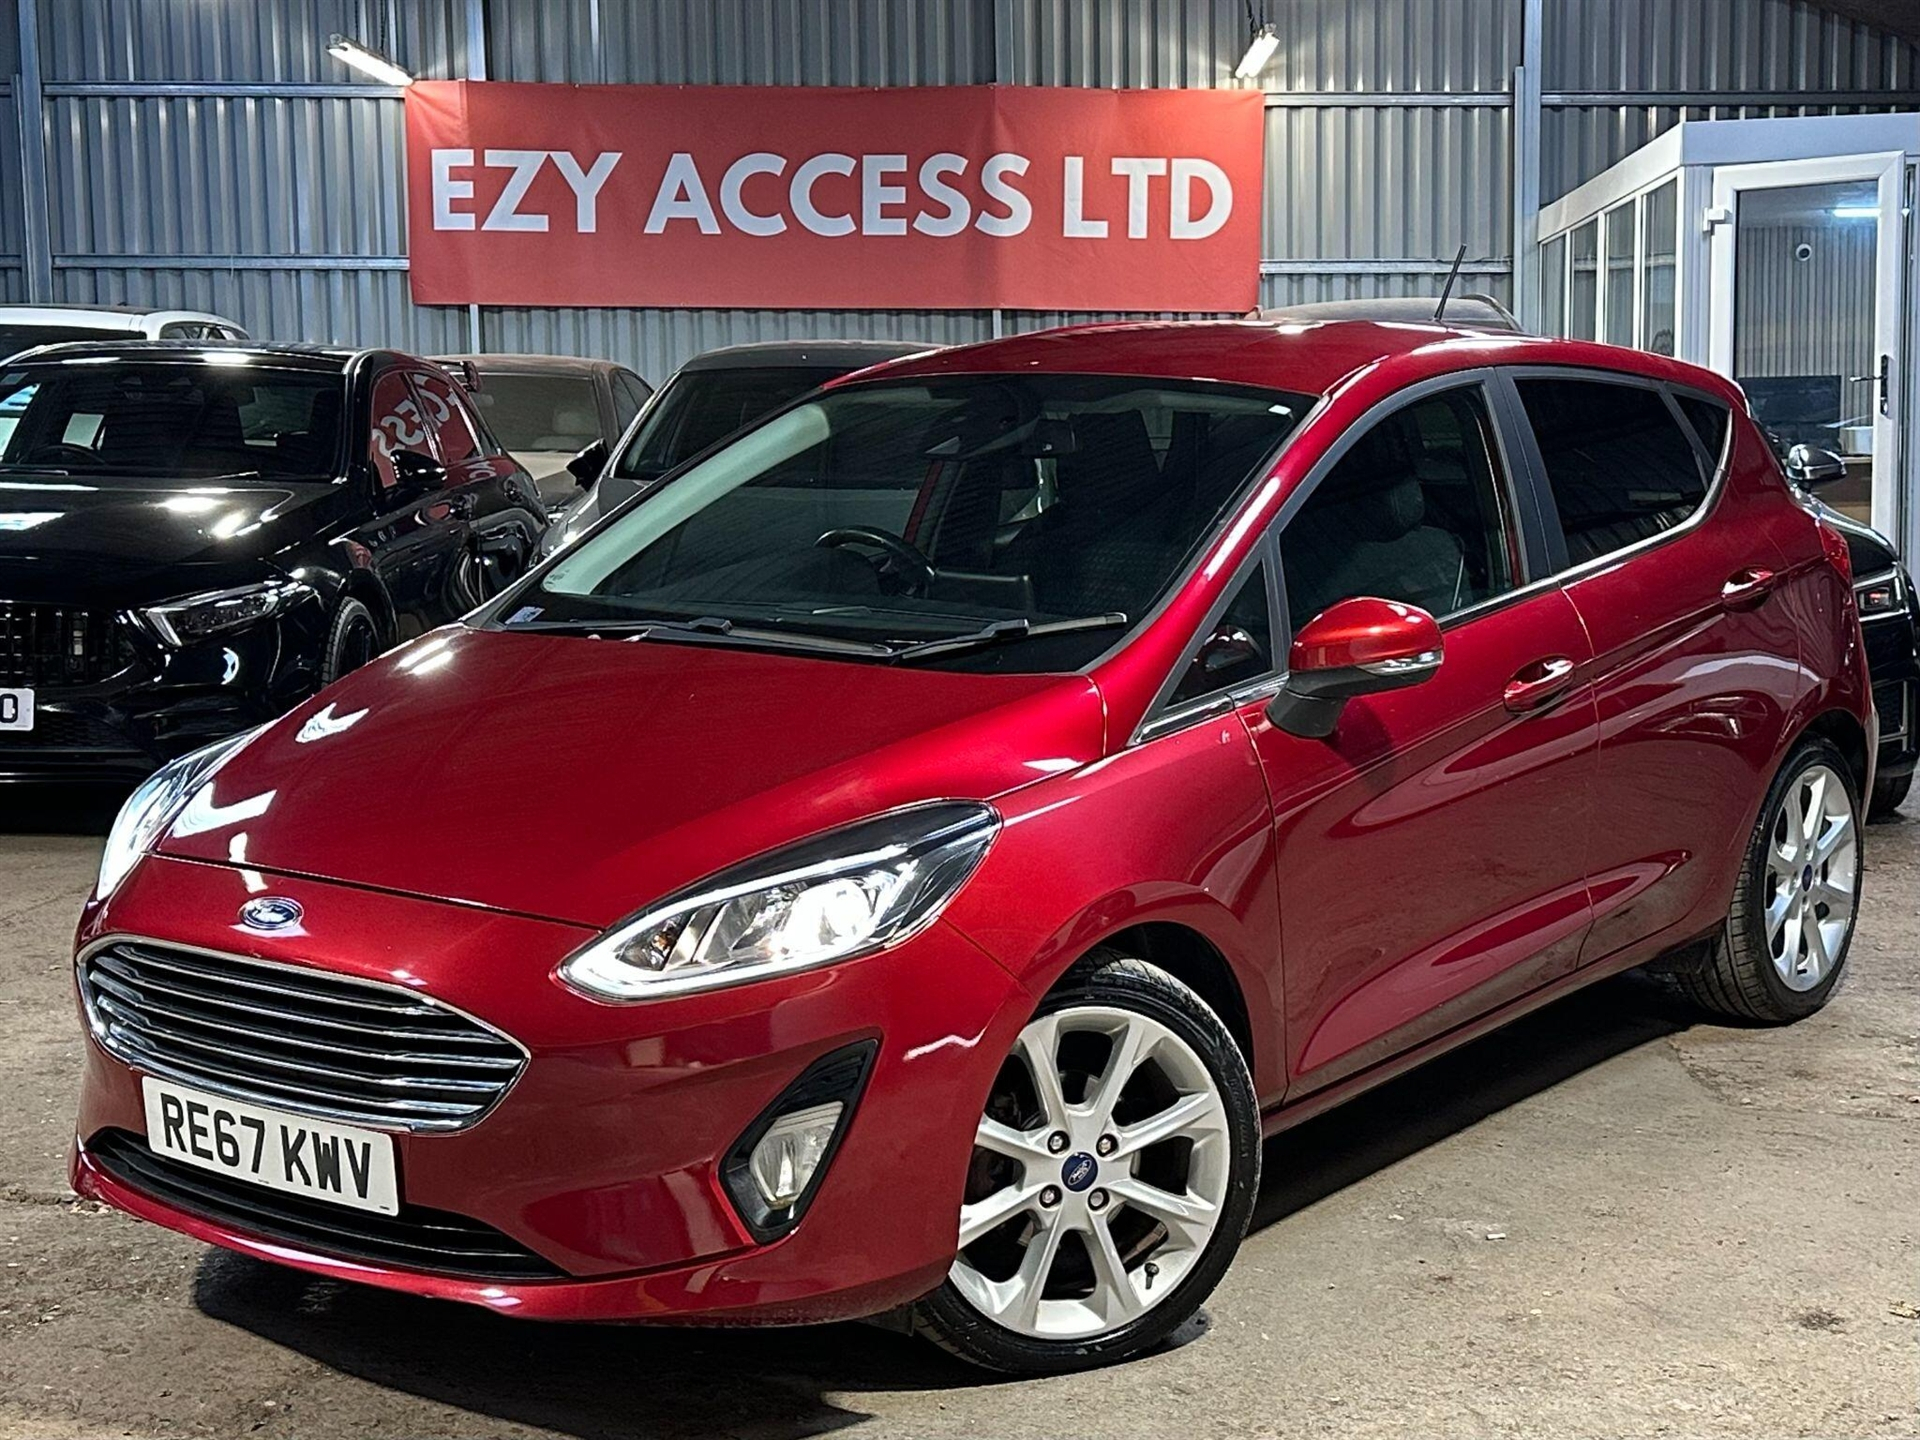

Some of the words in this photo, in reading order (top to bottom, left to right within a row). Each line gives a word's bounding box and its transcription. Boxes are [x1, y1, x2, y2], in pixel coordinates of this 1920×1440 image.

[430, 149, 622, 233] EZY
[644, 153, 1033, 237] ACCESS
[1064, 156, 1234, 240] LTD
[160, 1092, 265, 1174] RE67
[281, 1124, 371, 1199] KWV
